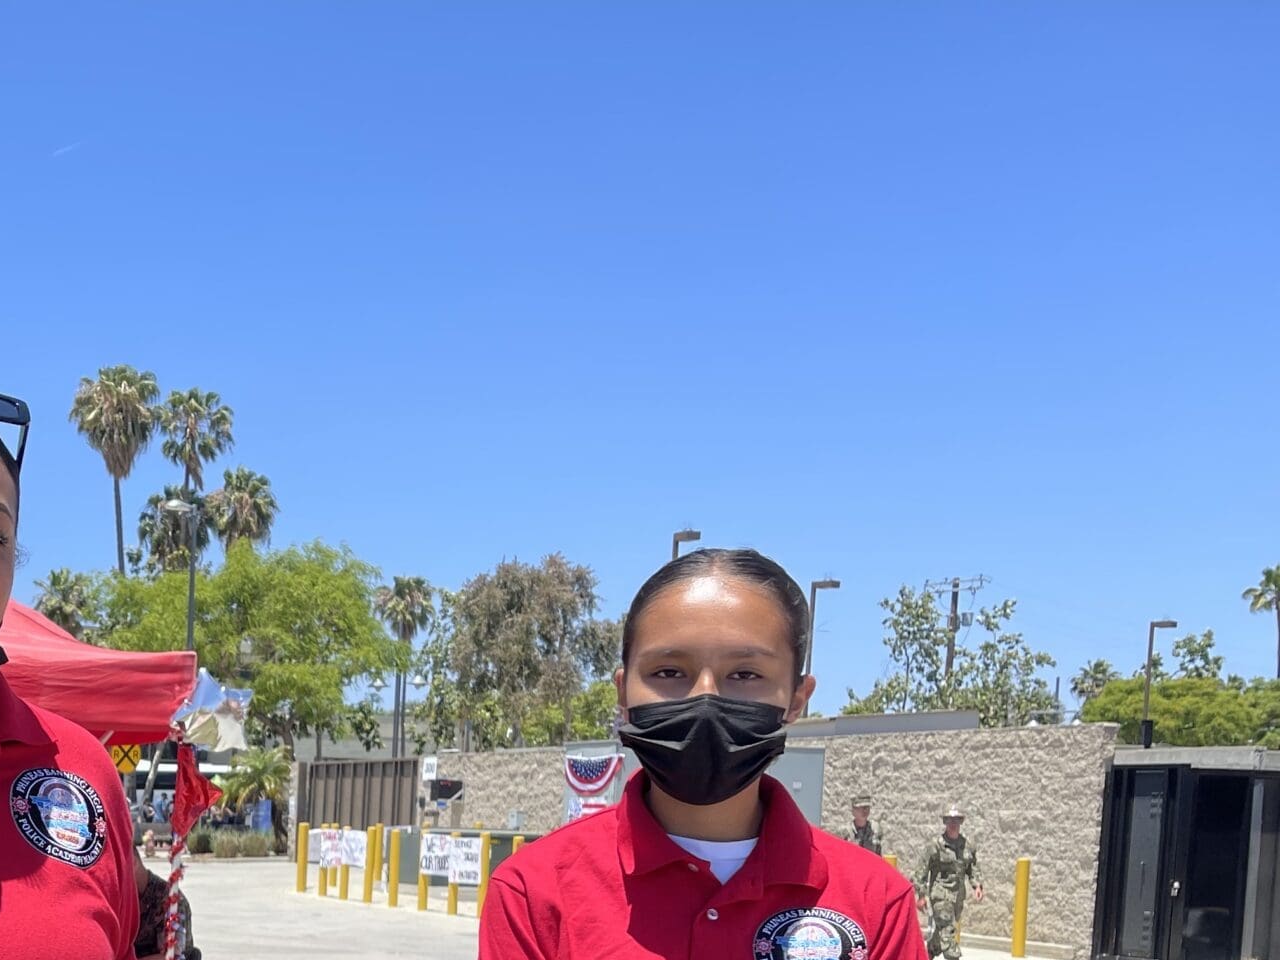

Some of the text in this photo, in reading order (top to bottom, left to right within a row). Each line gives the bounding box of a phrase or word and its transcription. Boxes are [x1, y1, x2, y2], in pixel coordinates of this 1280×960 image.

[16, 769, 104, 813] PHINEAS BANNING HIGH
[18, 818, 47, 848] POLICE
[762, 910, 864, 942] PHINEAS BANNING HIGH
